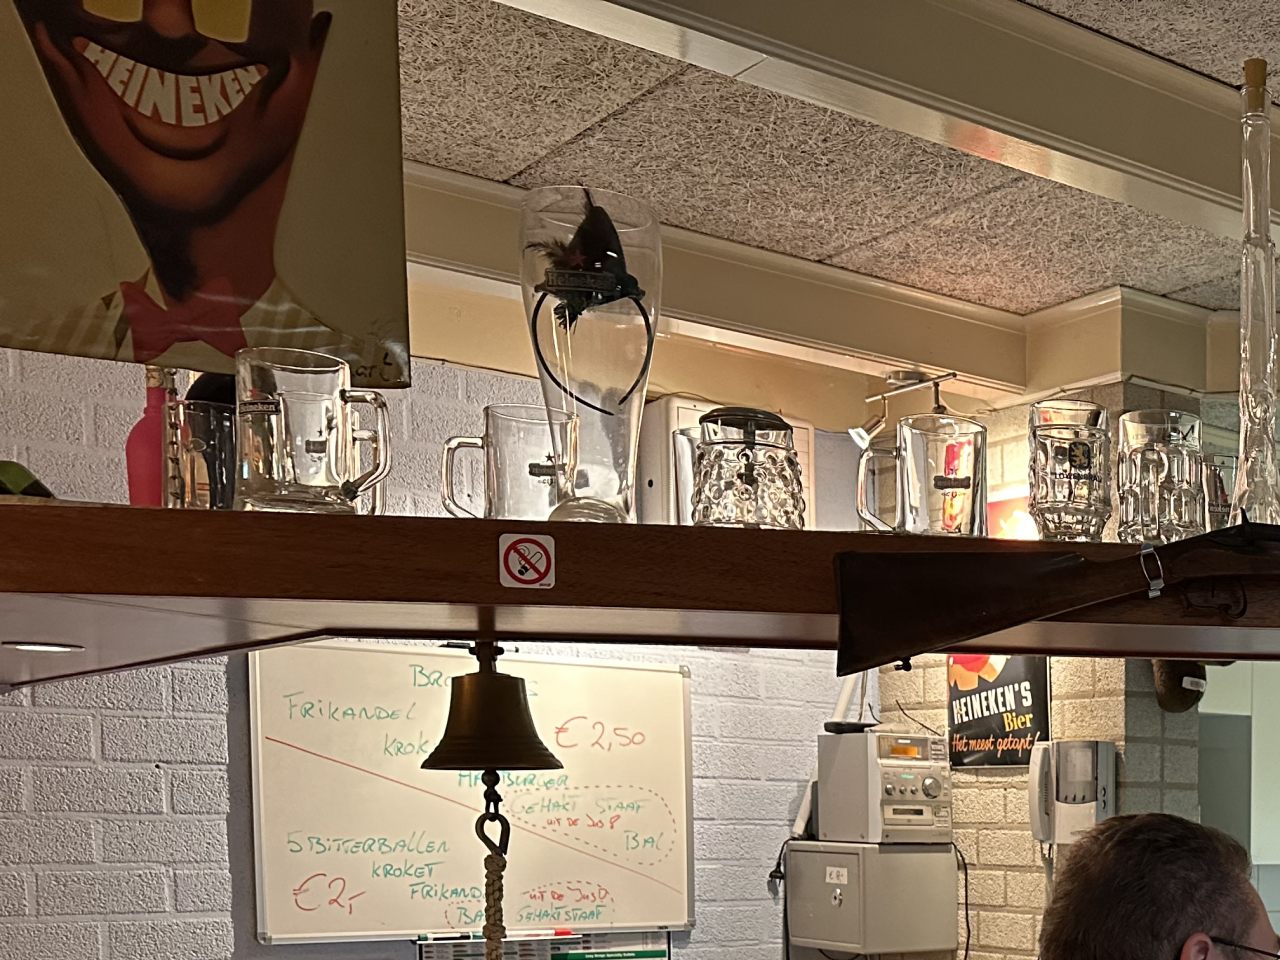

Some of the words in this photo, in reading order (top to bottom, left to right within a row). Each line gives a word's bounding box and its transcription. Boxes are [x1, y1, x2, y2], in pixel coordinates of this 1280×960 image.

[82, 45, 259, 127] HEINEKEN
[952, 681, 1033, 725] HEINEKEN'S
[1002, 712, 1034, 732] Bier
[952, 733, 969, 753] Het
[968, 734, 996, 751] meest
